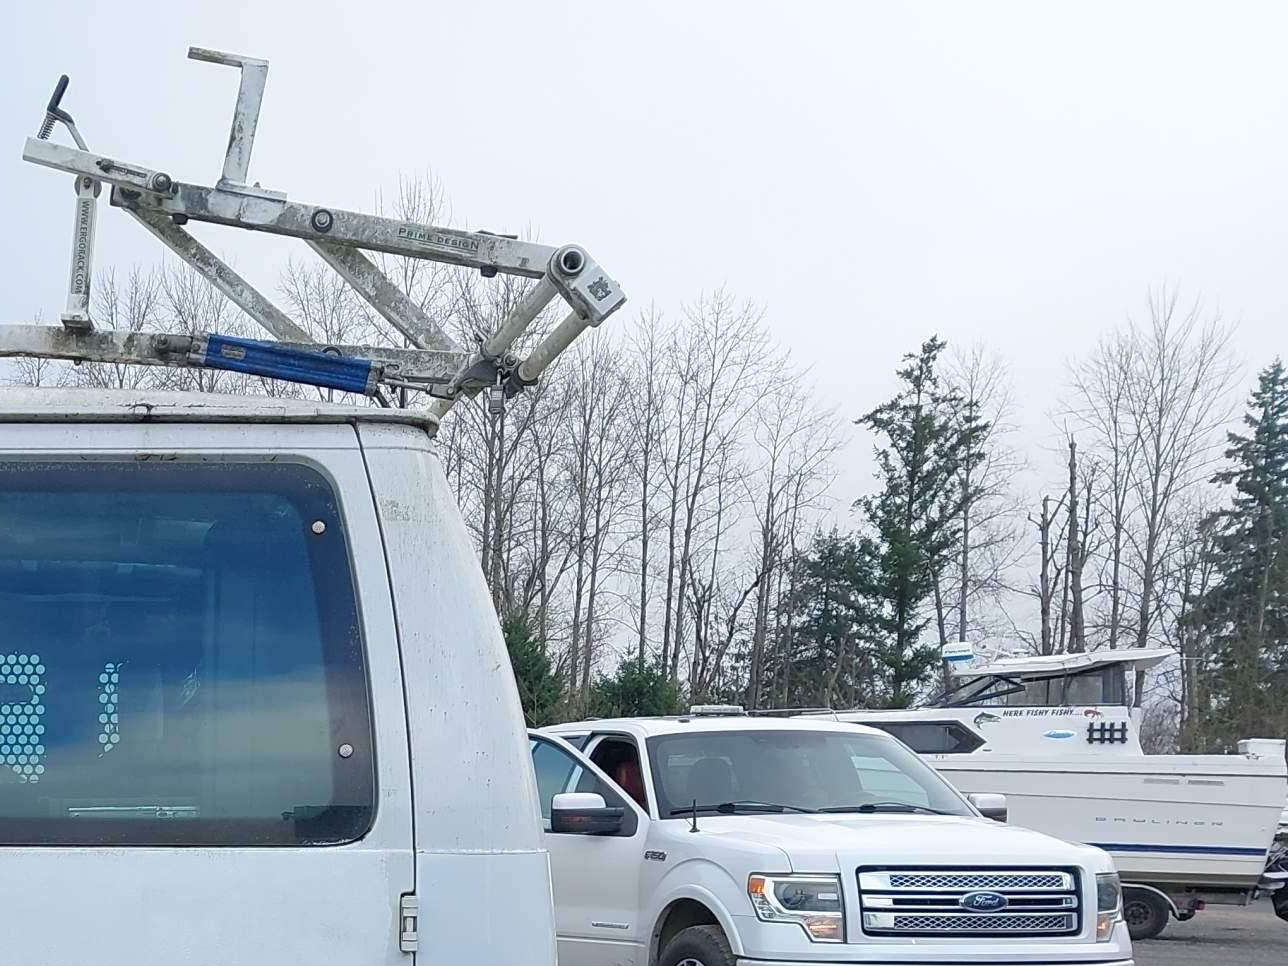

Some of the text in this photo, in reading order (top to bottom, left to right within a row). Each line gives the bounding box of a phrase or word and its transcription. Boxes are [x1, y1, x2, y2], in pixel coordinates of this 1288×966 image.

[74, 200, 89, 294] WWW.ERGORACK.COM
[1002, 709, 1024, 717] HERE
[973, 894, 1000, 906] Ford
